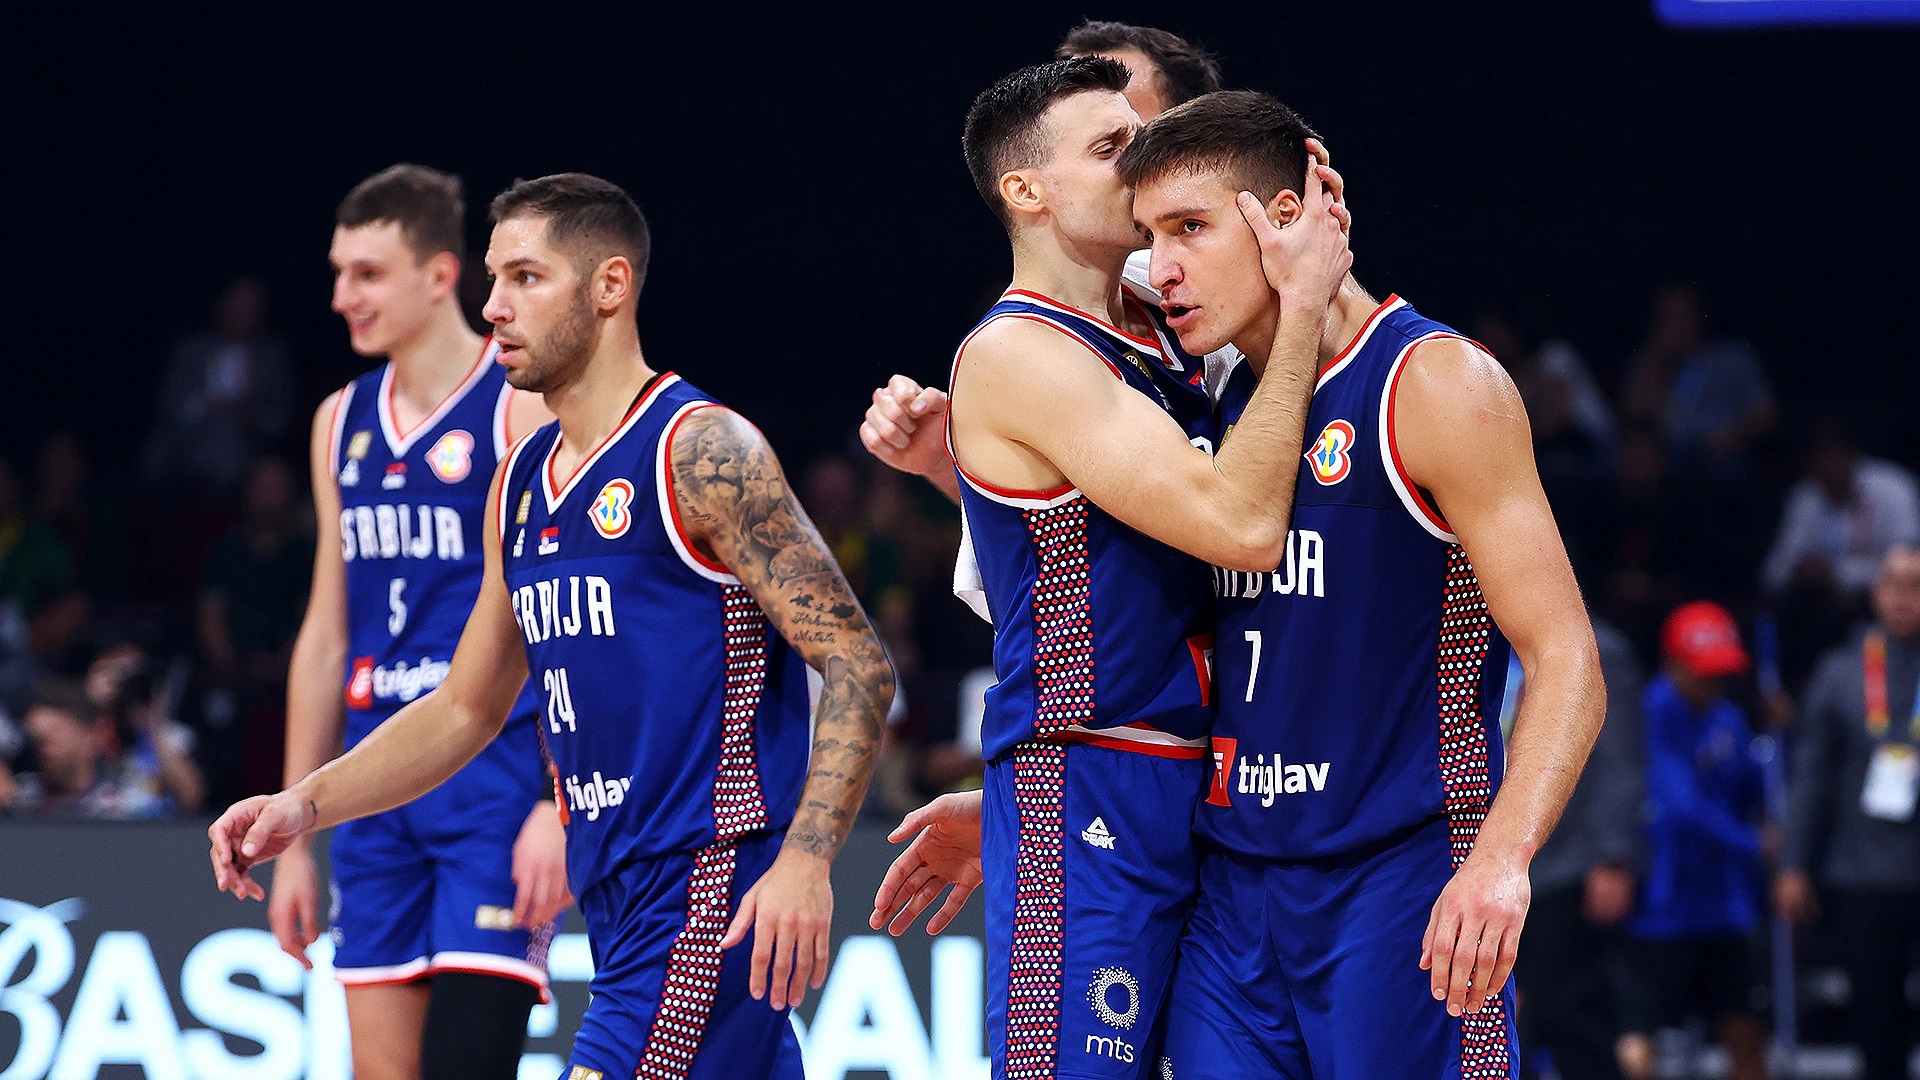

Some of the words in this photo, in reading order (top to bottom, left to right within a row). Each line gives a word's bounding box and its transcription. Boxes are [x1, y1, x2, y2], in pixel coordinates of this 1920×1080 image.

[340, 503, 465, 562] SRBIJA
[388, 577, 408, 637] 5
[1244, 630, 1262, 702] 7
[544, 667, 577, 734] 24
[1237, 753, 1331, 808] triglav
[1085, 1034, 1134, 1063] mts
